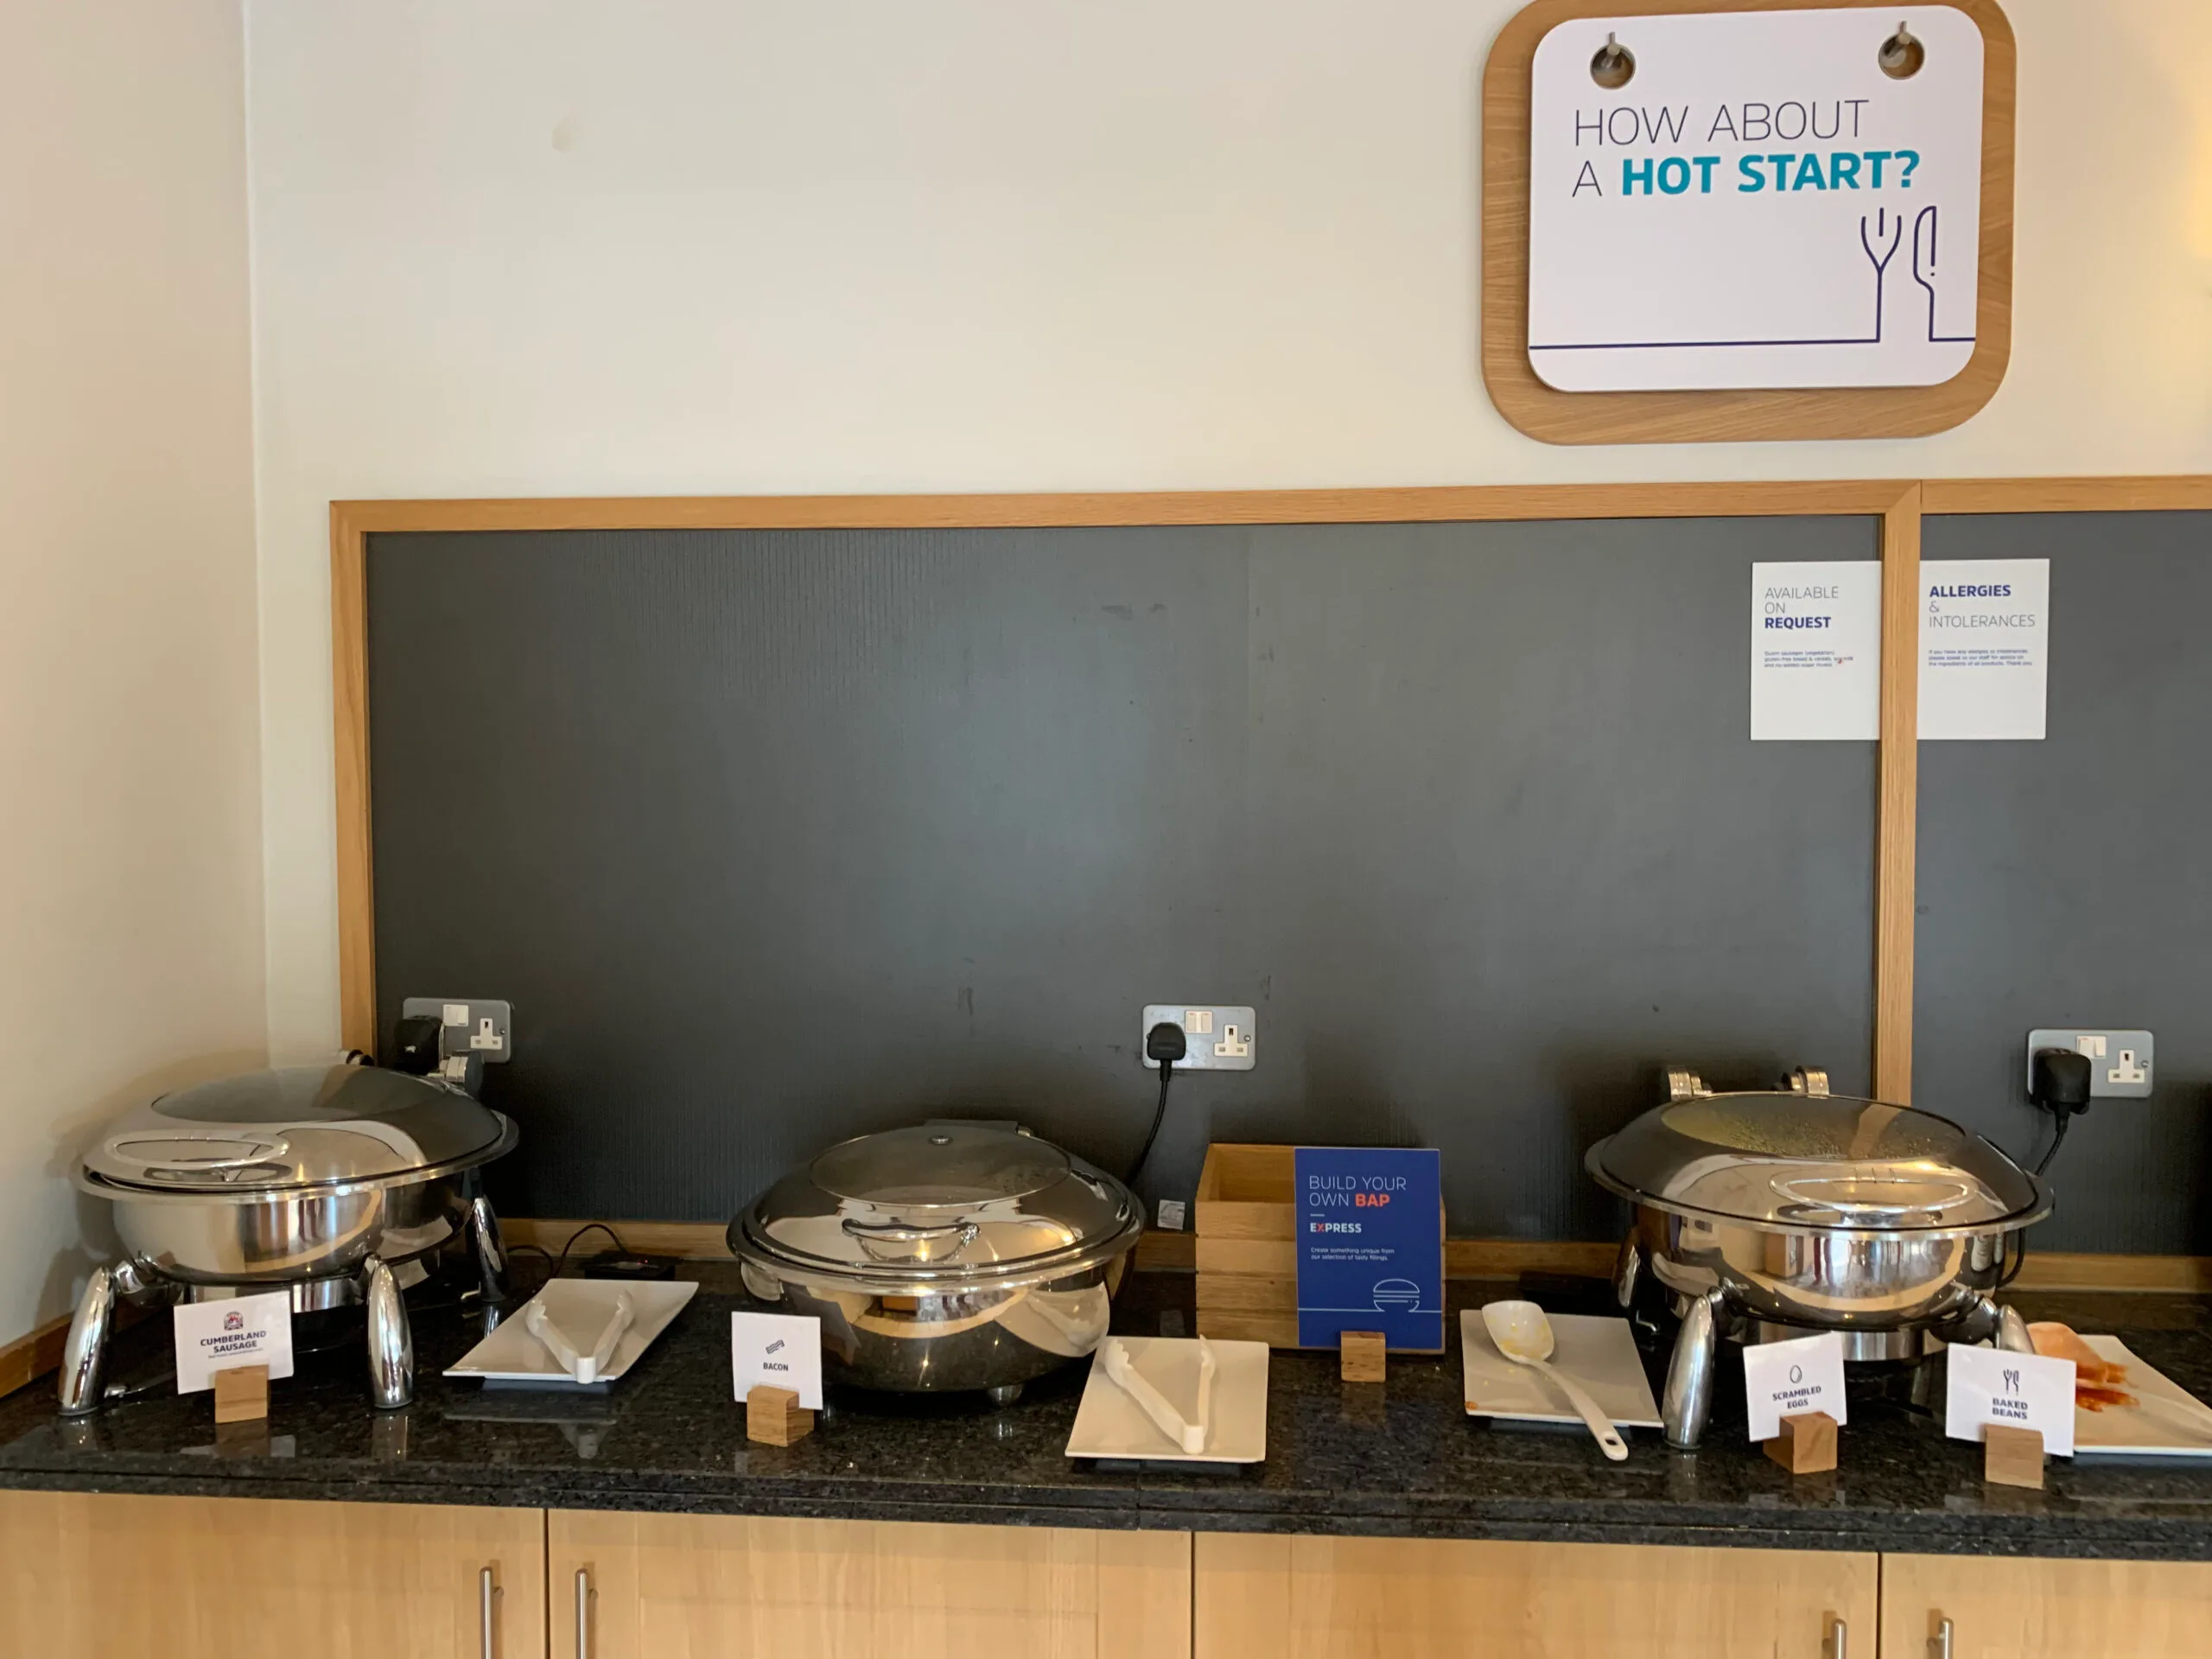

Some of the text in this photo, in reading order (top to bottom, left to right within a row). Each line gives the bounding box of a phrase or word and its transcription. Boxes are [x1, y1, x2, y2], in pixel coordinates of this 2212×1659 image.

[1574, 99, 1870, 147] HOW ABOUT
[1571, 149, 1921, 198] A HOT START?
[1764, 586, 1839, 599] AVAILABLE
[1929, 584, 2012, 597] ALLERGIES
[1764, 601, 1786, 614] ON
[1929, 601, 1940, 613] &
[1764, 616, 1832, 630] REQUEST
[1929, 614, 2036, 628] INTOLERANCES
[1309, 1175, 1407, 1191] BUILD YOUR
[1309, 1192, 1390, 1207] OWN BAP
[1310, 1223, 1362, 1233] EXPRESS
[200, 1331, 267, 1347] CUMBERLAND
[213, 1340, 257, 1353] SAUSAGE
[763, 1362, 789, 1371] BACON
[1772, 1385, 1821, 1402] SCRAMBLED
[1787, 1398, 1808, 1409] EGGS
[1993, 1397, 2029, 1411] BAKED
[1992, 1407, 2028, 1421] BEANS
